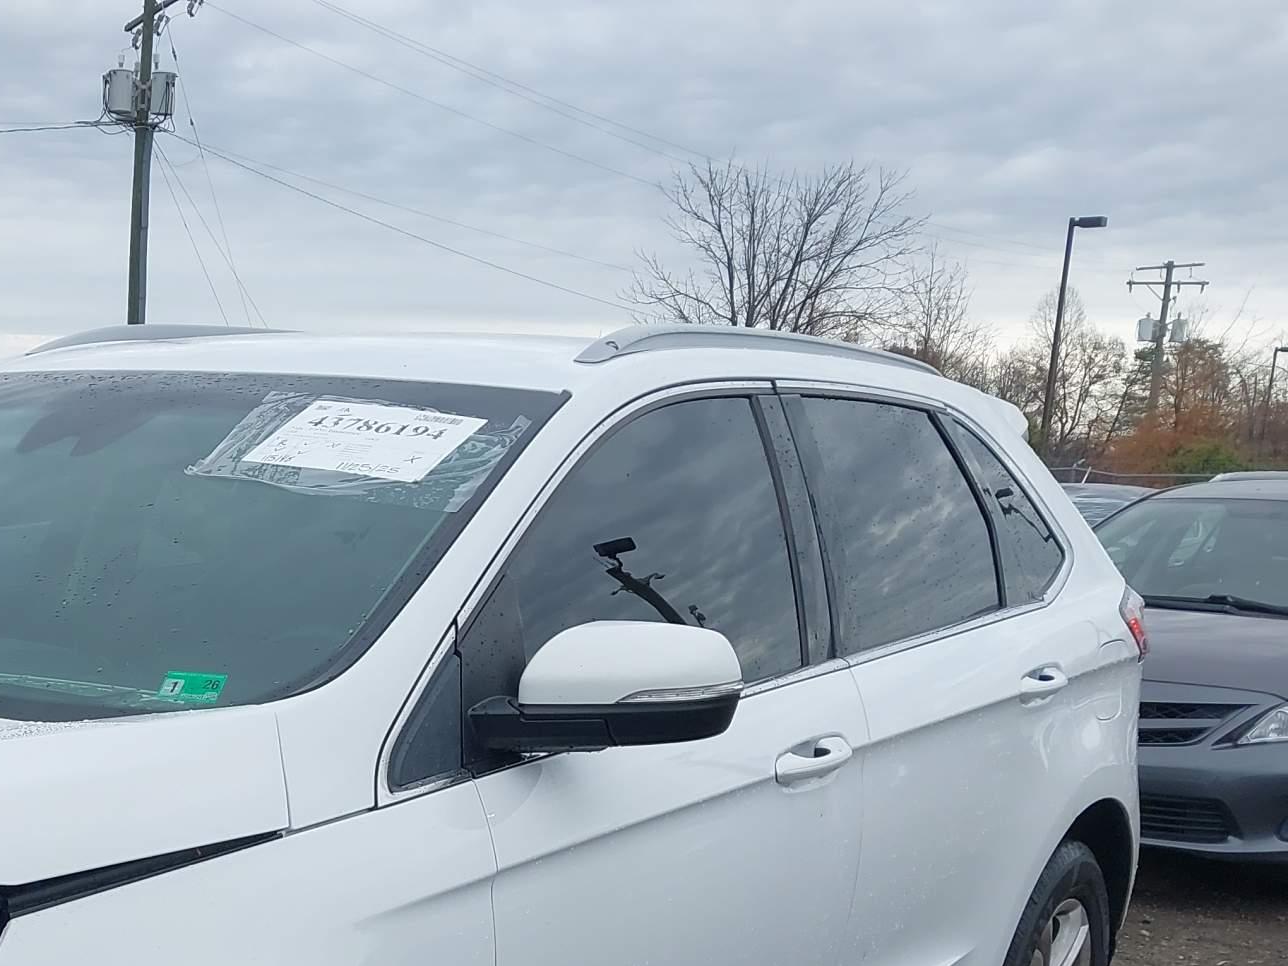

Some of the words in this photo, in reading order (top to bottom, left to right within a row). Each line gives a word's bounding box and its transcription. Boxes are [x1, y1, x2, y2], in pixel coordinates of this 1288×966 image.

[307, 414, 449, 440] 43786194
[168, 681, 179, 693] 1
[203, 679, 221, 690] 26
